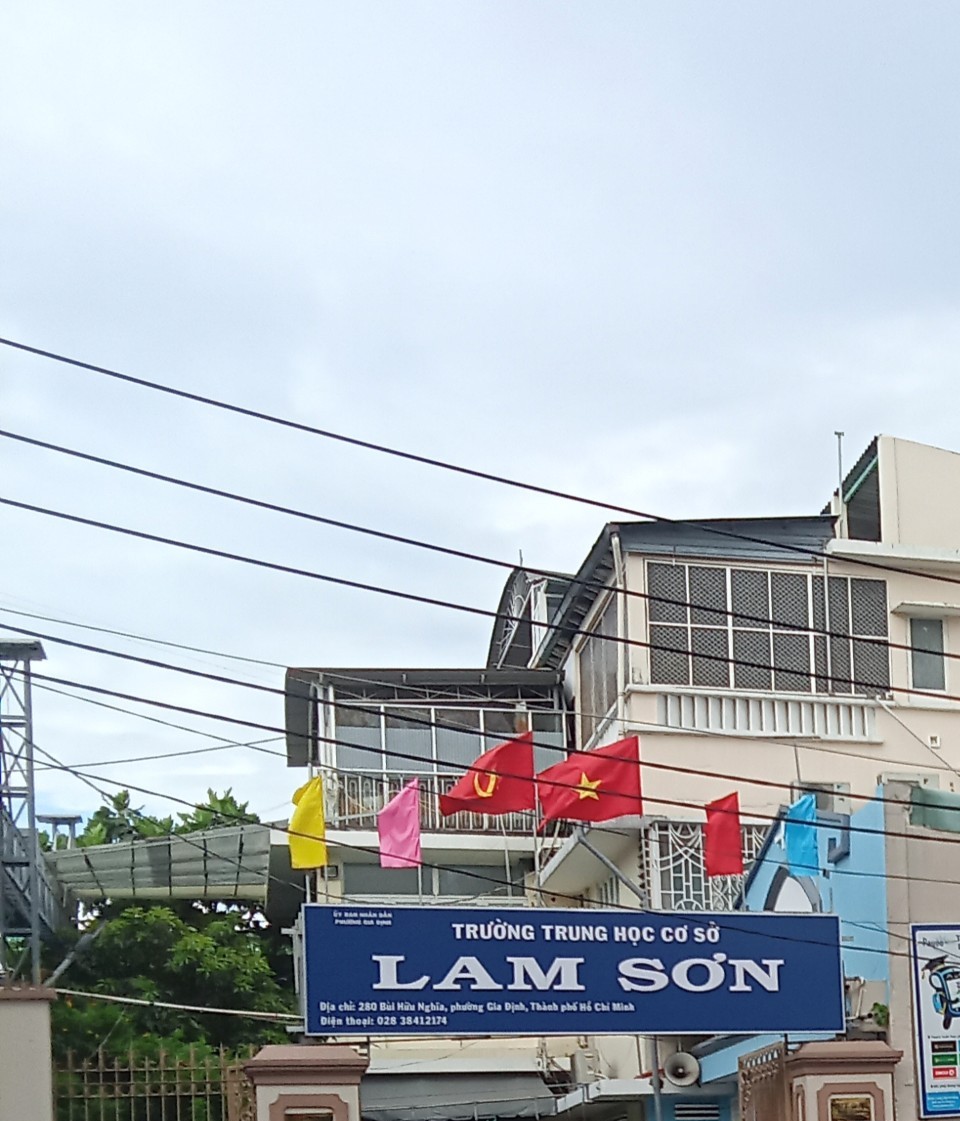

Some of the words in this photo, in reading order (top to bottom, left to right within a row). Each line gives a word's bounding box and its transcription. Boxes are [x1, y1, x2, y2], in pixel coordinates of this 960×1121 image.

[451, 918, 534, 941] TRƯỜNG
[541, 924, 608, 942] TRUNG
[614, 925, 655, 947] HỌC
[660, 924, 688, 943] CƠ
[693, 920, 721, 943] SỞ
[371, 954, 585, 991] LAM
[617, 952, 784, 992] SƠN
[319, 1001, 336, 1013] Địa
[358, 1002, 377, 1011] 280
[379, 1001, 395, 1011] Bùi
[397, 1001, 415, 1011] Hữu
[417, 1001, 448, 1013] Nghĩa,
[450, 1001, 484, 1013] phường
[486, 1002, 502, 1011] Gia
[504, 1001, 529, 1013] Định,
[530, 1001, 558, 1011] Thành
[560, 1001, 578, 1012] phố
[579, 1000, 592, 1011] Hồ
[594, 1001, 610, 1011] Chí
[612, 1002, 635, 1011] Minh
[320, 1016, 343, 1027] Điện
[345, 1016, 374, 1027] thoại:
[376, 1016, 397, 1025] 028
[400, 1016, 447, 1025] 38412174
